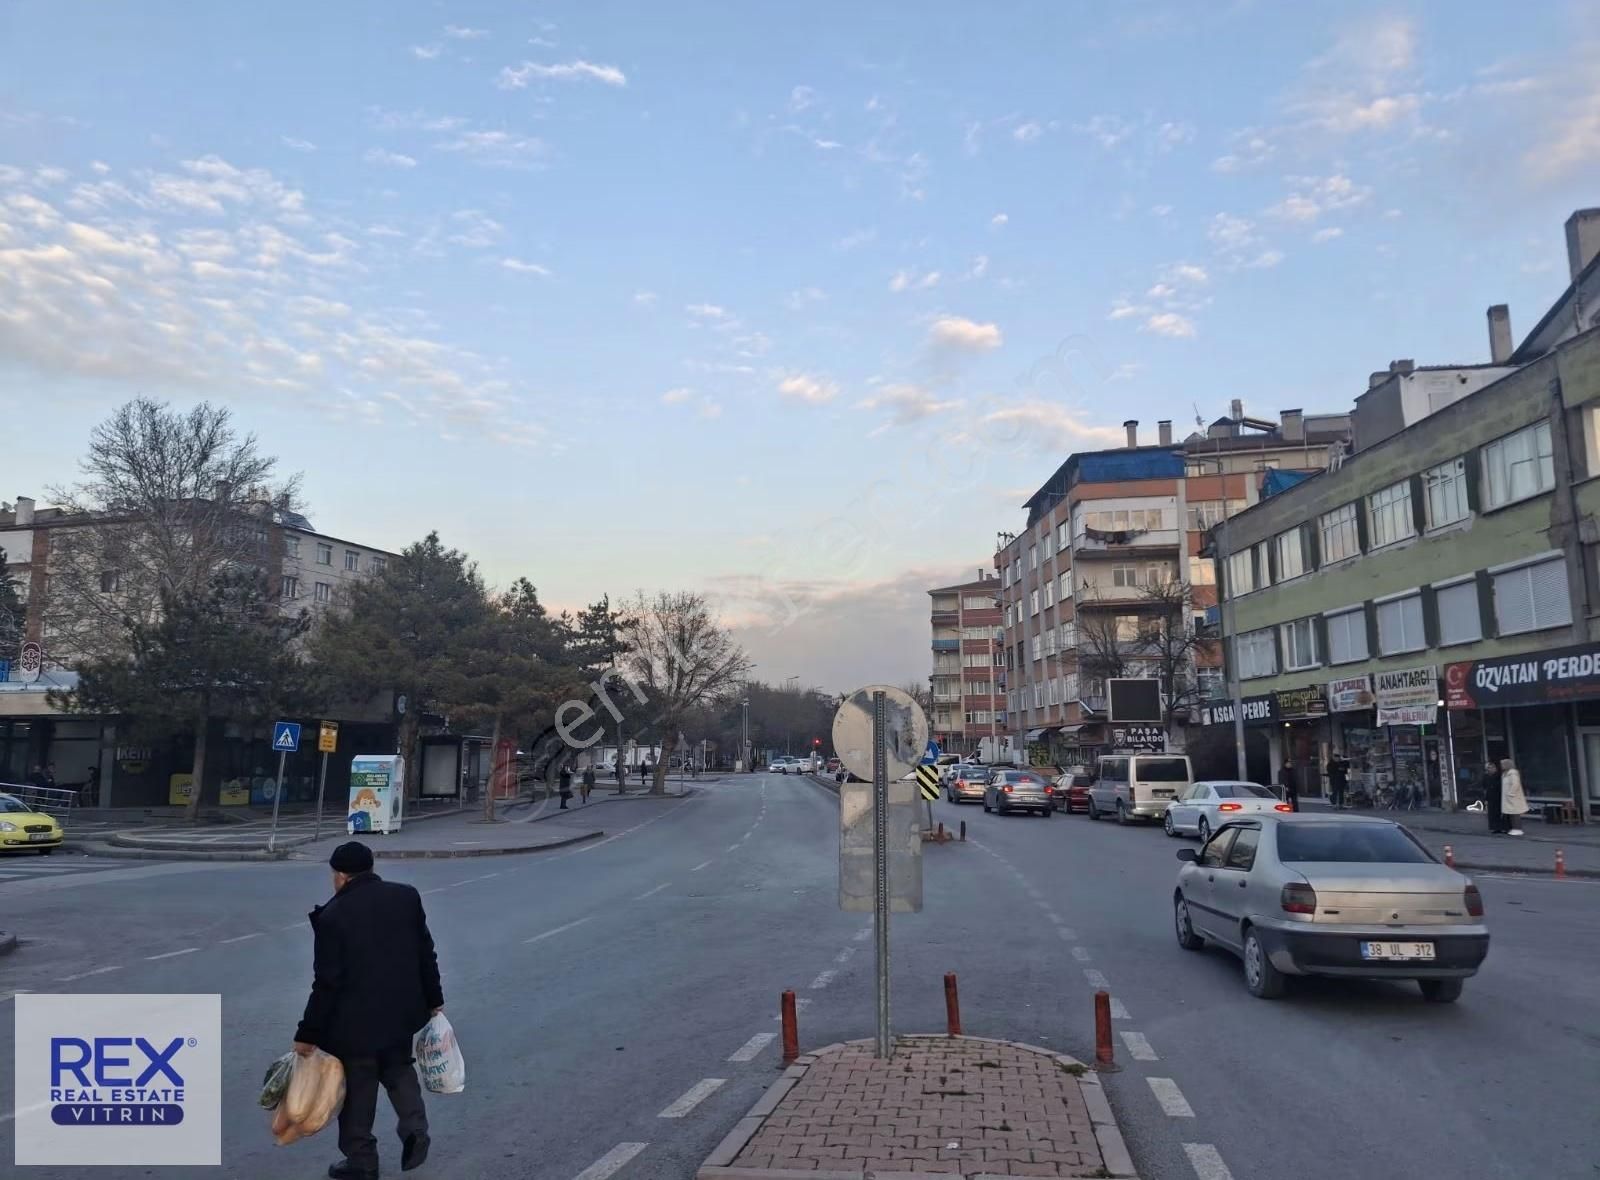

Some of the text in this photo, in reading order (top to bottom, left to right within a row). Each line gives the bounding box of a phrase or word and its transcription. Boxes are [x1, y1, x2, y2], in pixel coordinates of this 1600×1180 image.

[1476, 662, 1539, 693] ÖZVATAN
[1543, 653, 1600, 681] PERDE
[1213, 700, 1271, 723] ASGA PERDE
[1369, 944, 1432, 956] 38 UL 312
